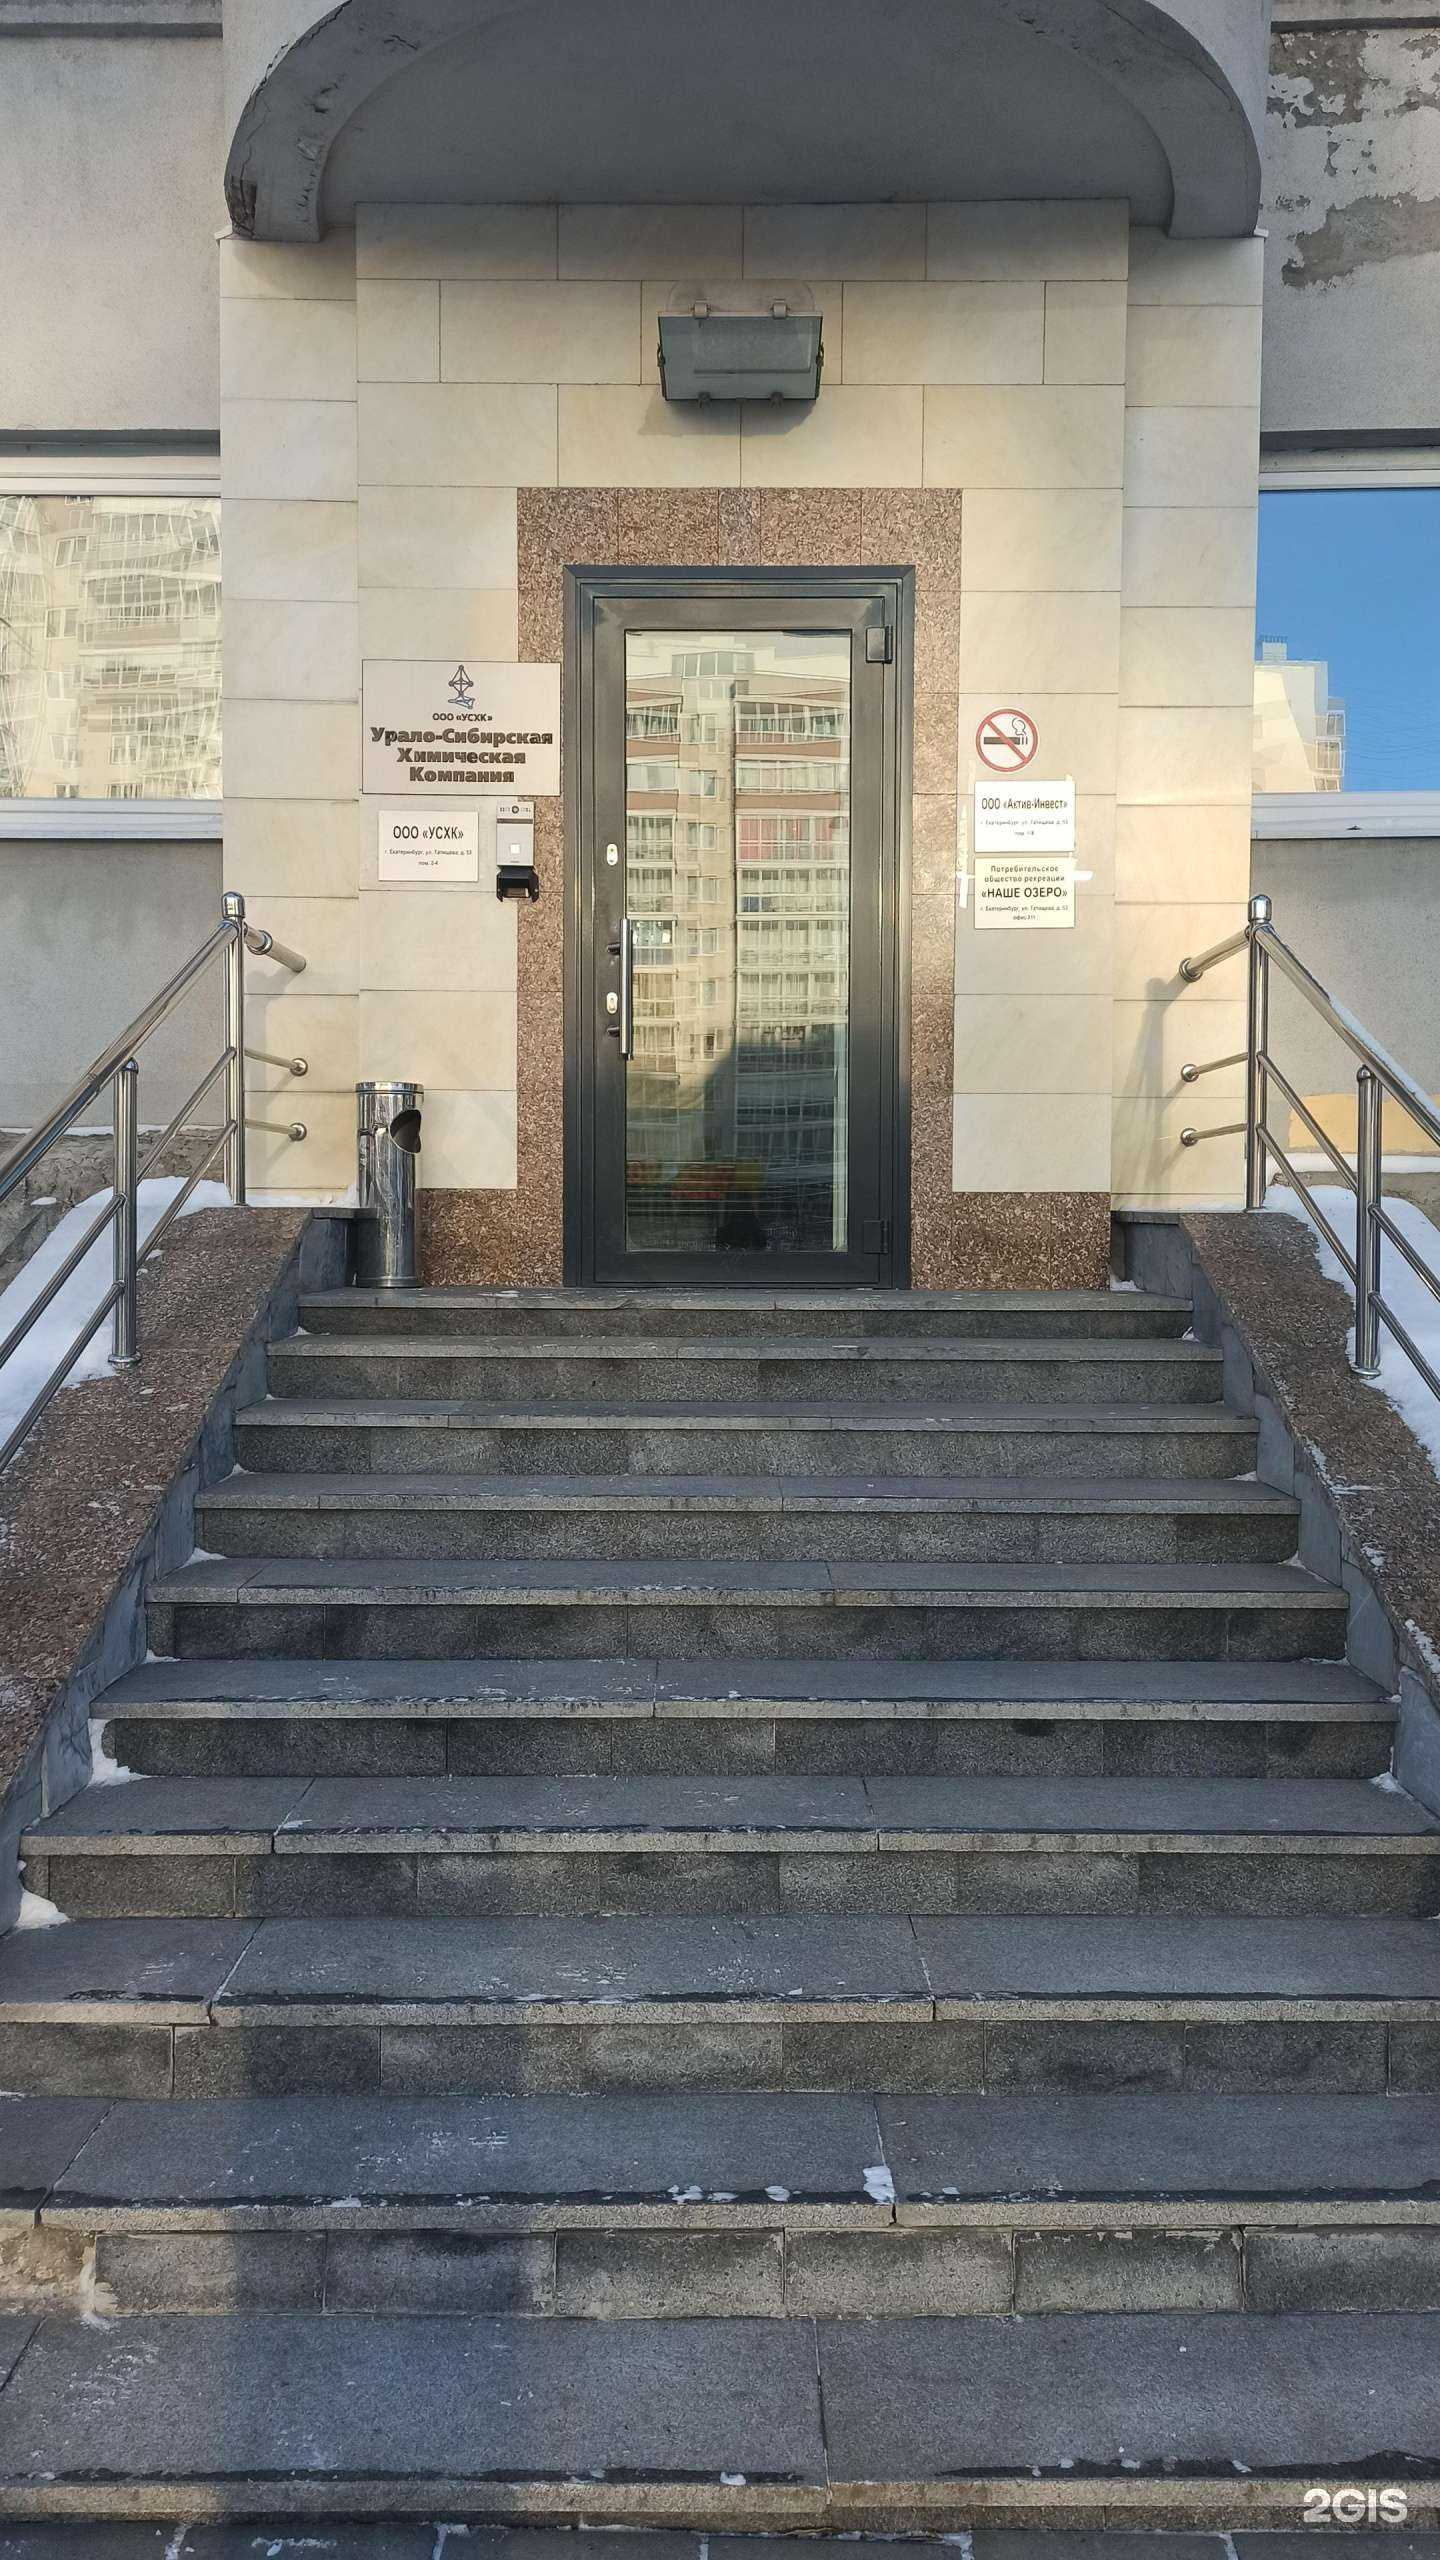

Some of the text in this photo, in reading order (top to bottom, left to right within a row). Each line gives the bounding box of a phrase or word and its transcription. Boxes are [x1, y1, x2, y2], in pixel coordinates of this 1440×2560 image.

[432, 712, 493, 722] ООО «УСХК»
[370, 726, 553, 748] Урало-Сибирская
[396, 747, 526, 764] Химическая
[409, 766, 515, 783] Компания
[981, 797, 1068, 810] ООО «Актив-Инвест»
[393, 825, 464, 840] ООО «УСХК»
[991, 865, 1059, 874] Потребительское
[984, 875, 1022, 883] общество
[981, 886, 1068, 898] «НАШЕ ОЗЕРО»
